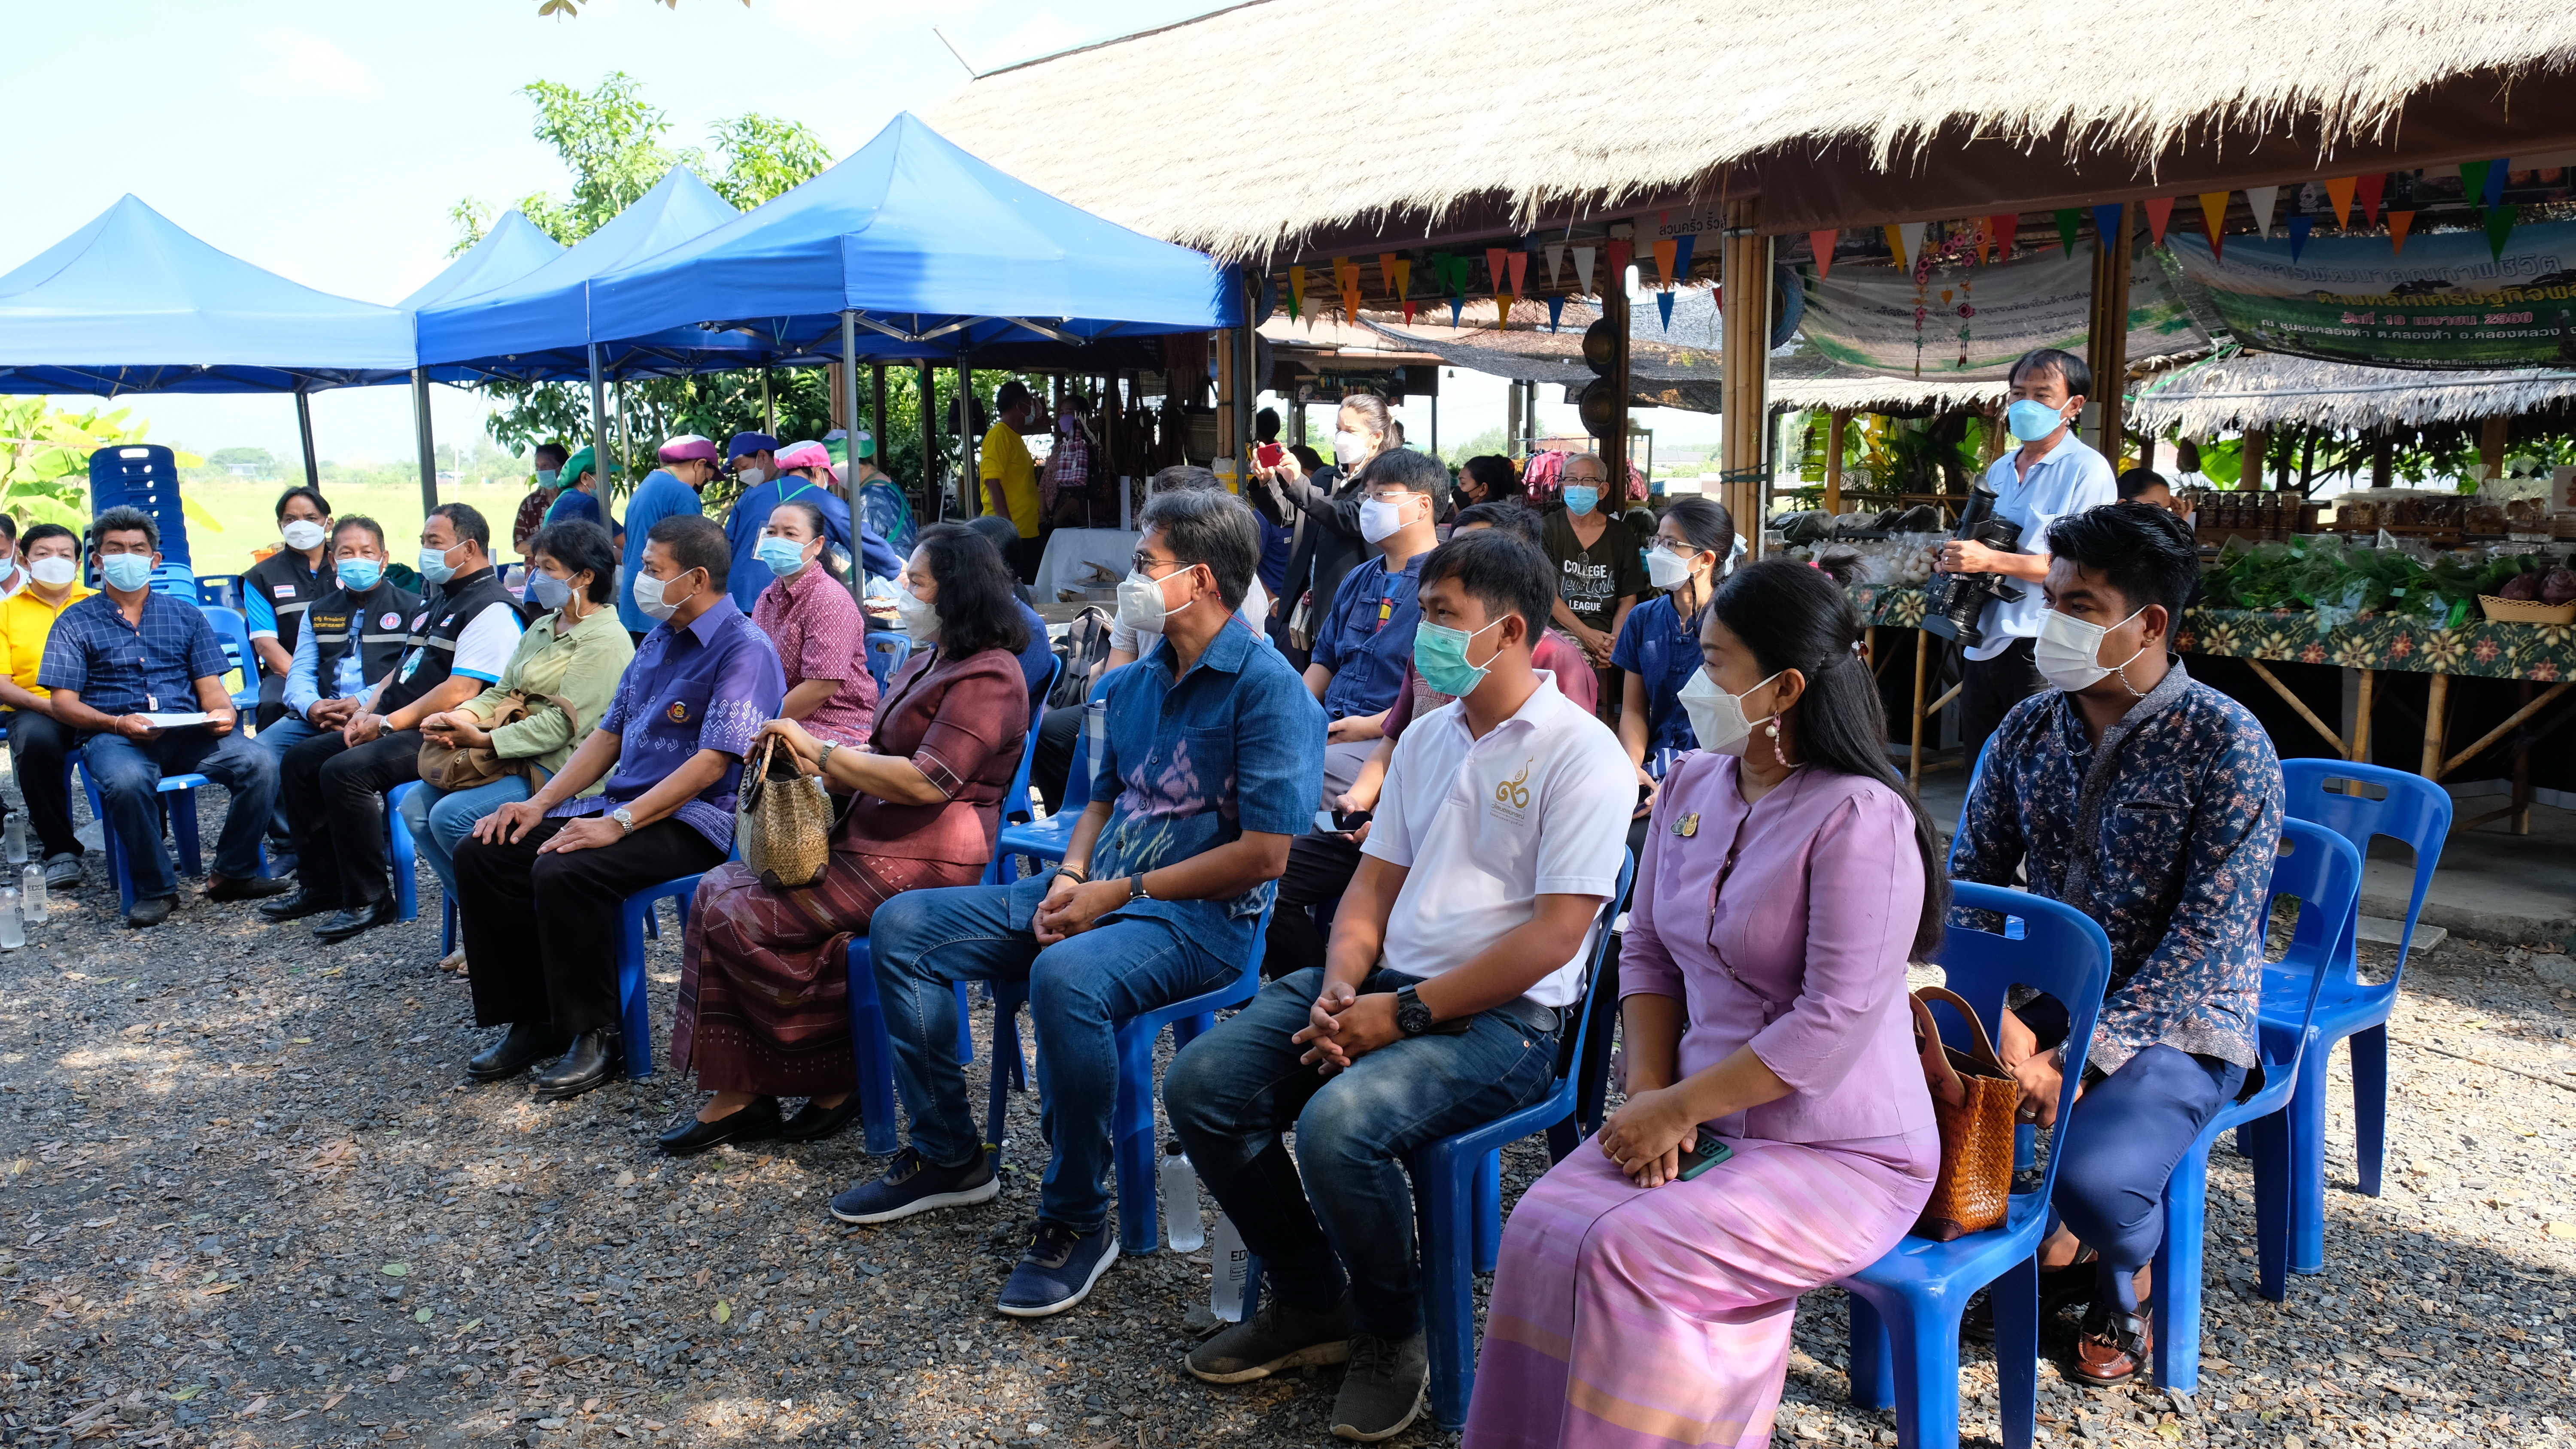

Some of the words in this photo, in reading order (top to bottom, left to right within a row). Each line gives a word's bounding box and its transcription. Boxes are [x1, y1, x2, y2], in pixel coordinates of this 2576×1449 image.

[2384, 315, 2406, 326] 10
[2484, 311, 2533, 325] 2560
[1564, 559, 1607, 578] COLLEGE
[1569, 600, 1601, 612] LEAGUE
